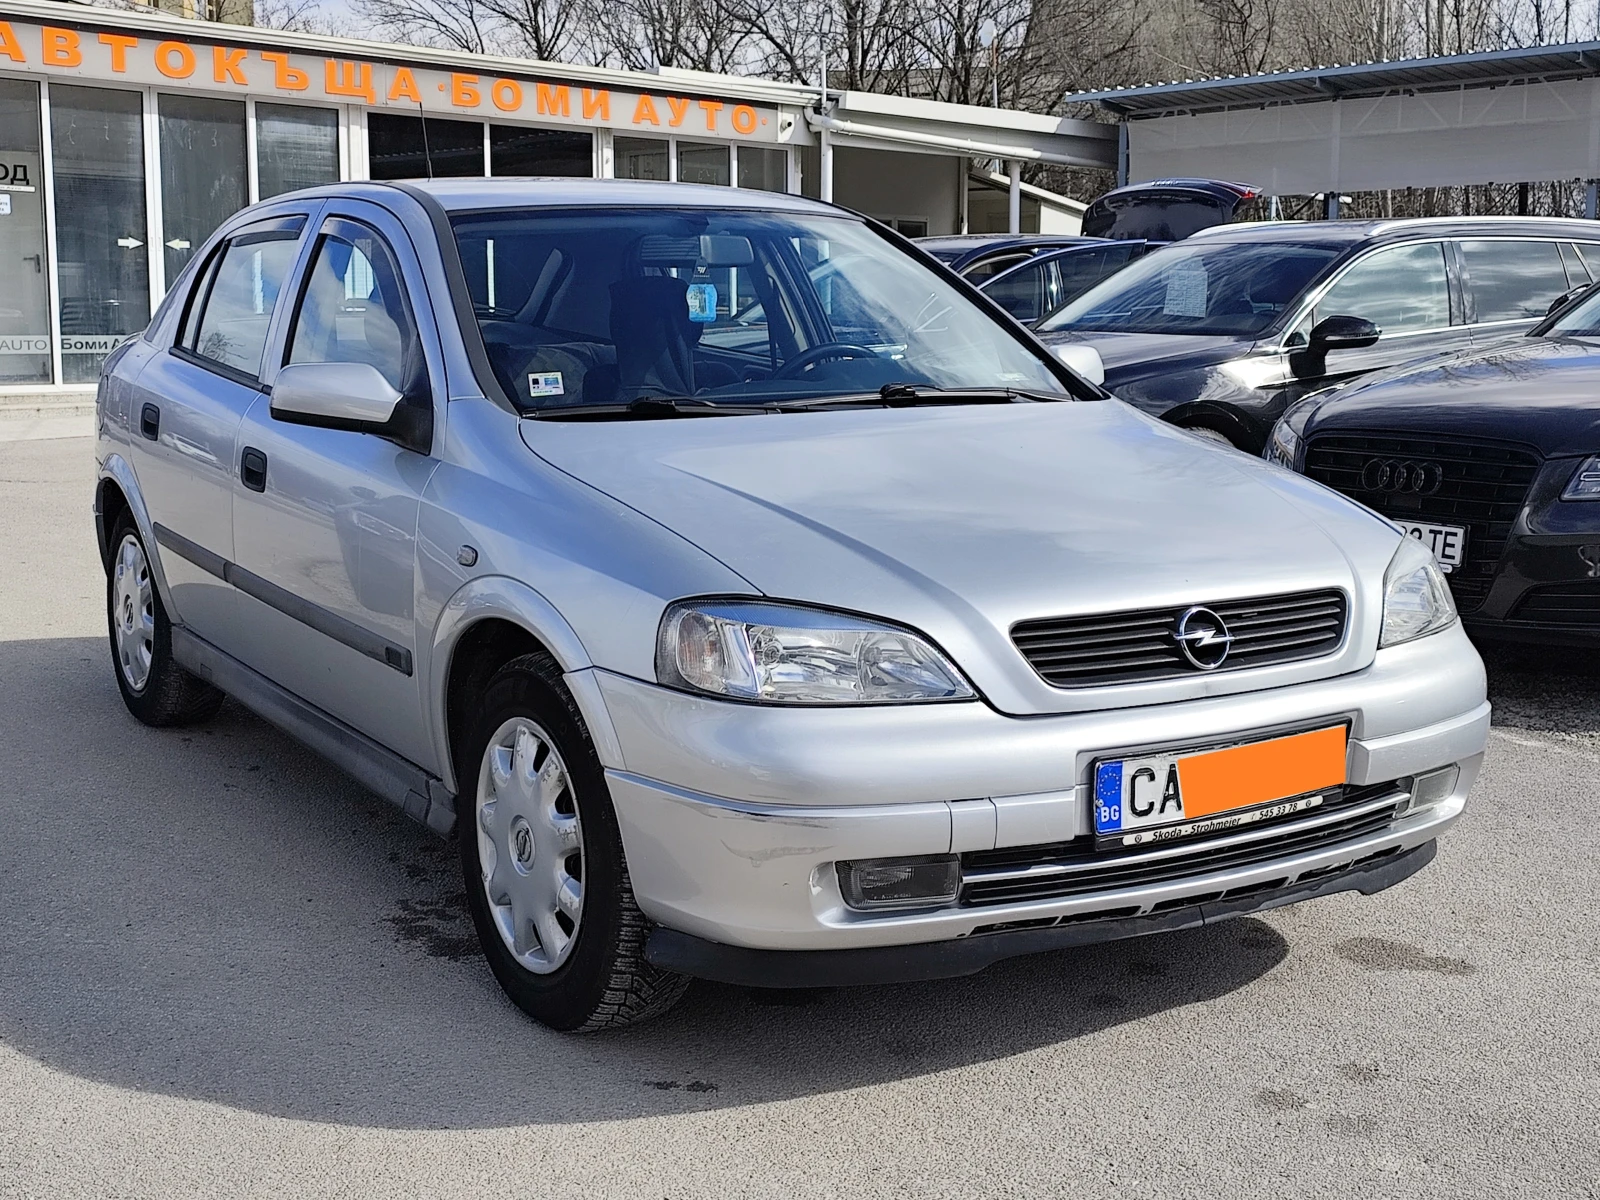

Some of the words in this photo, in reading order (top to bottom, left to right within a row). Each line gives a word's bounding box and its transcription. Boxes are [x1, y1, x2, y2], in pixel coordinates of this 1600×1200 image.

[0, 20, 421, 105] АВТОКЪЩА
[451, 72, 610, 121] БОМИ
[632, 94, 757, 134] АУТО
[1130, 763, 1182, 817] CA
[1101, 805, 1120, 823] BG
[1152, 828, 1182, 842] Skoda
[1190, 817, 1242, 835] Strohmeier
[1259, 807, 1274, 820] 545
[1275, 804, 1286, 816] 33
[1287, 802, 1298, 813] 78
